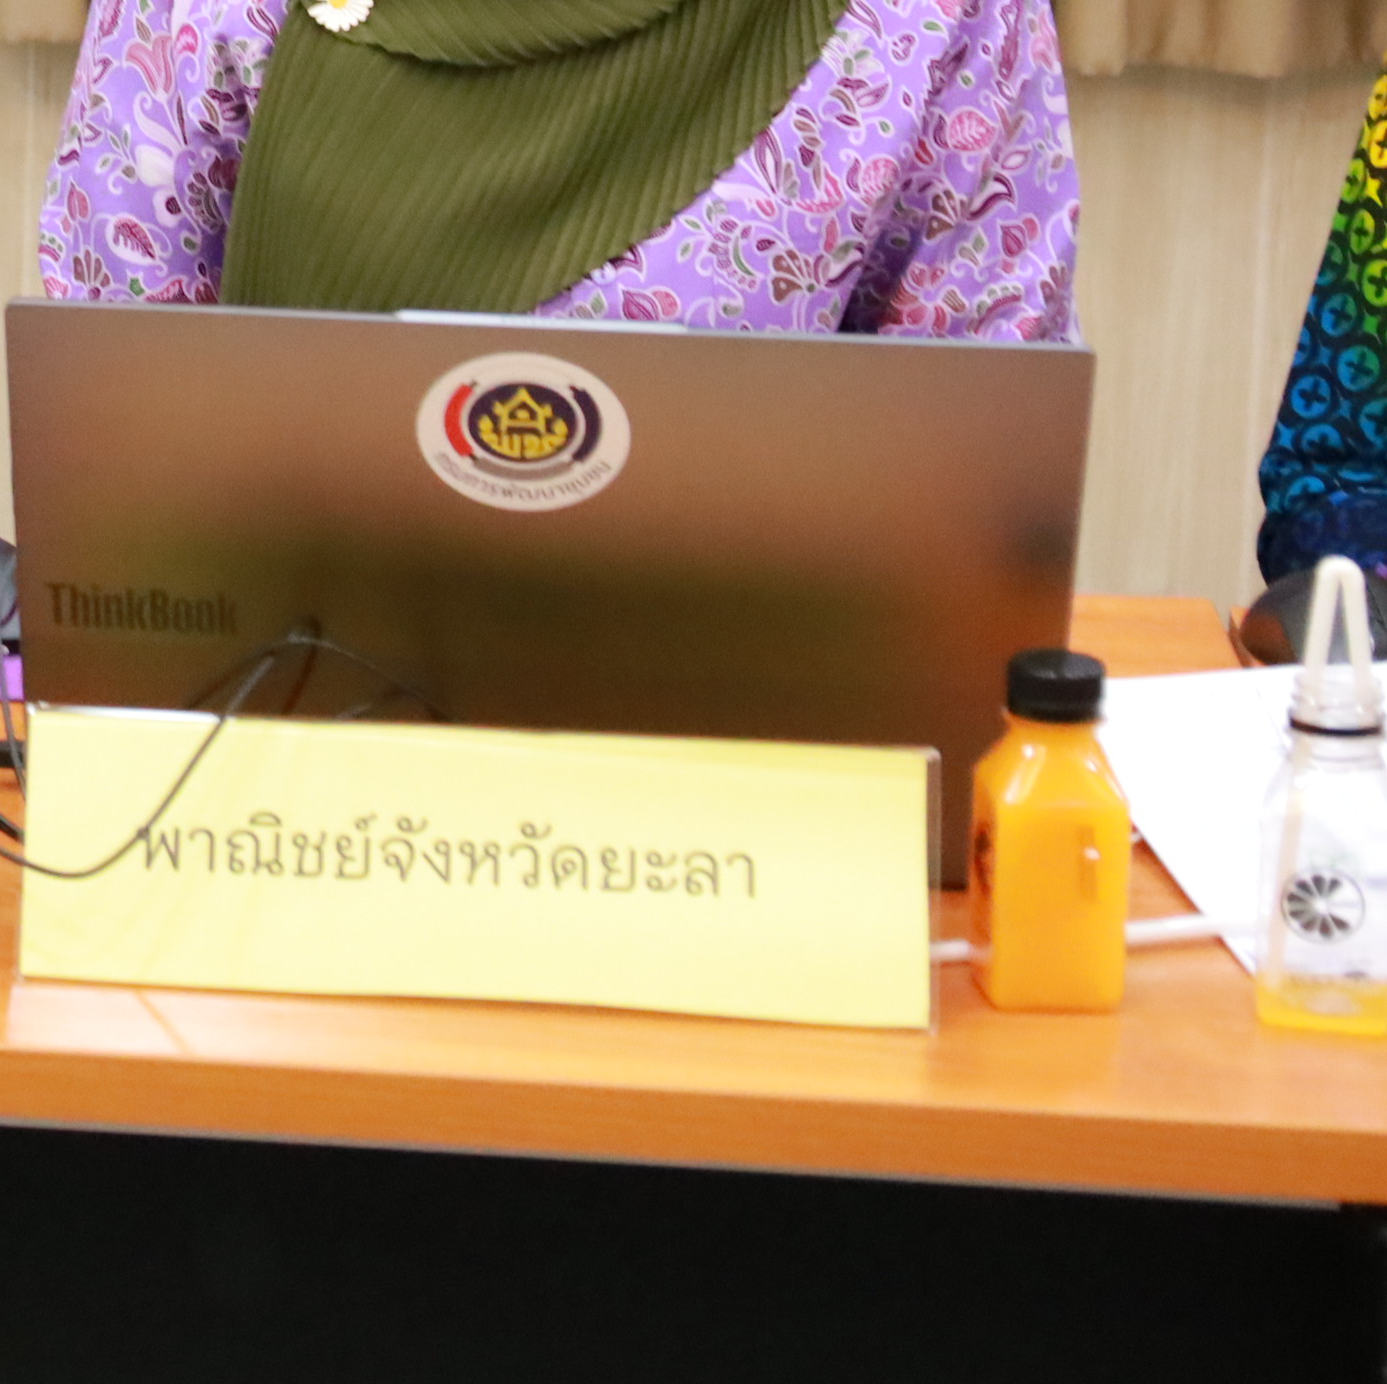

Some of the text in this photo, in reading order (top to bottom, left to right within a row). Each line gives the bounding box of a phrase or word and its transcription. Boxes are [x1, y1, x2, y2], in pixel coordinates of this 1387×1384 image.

[45, 582, 237, 637] ThinkBook
[141, 811, 757, 899] พาณิชย์จังหวัดยะลา
